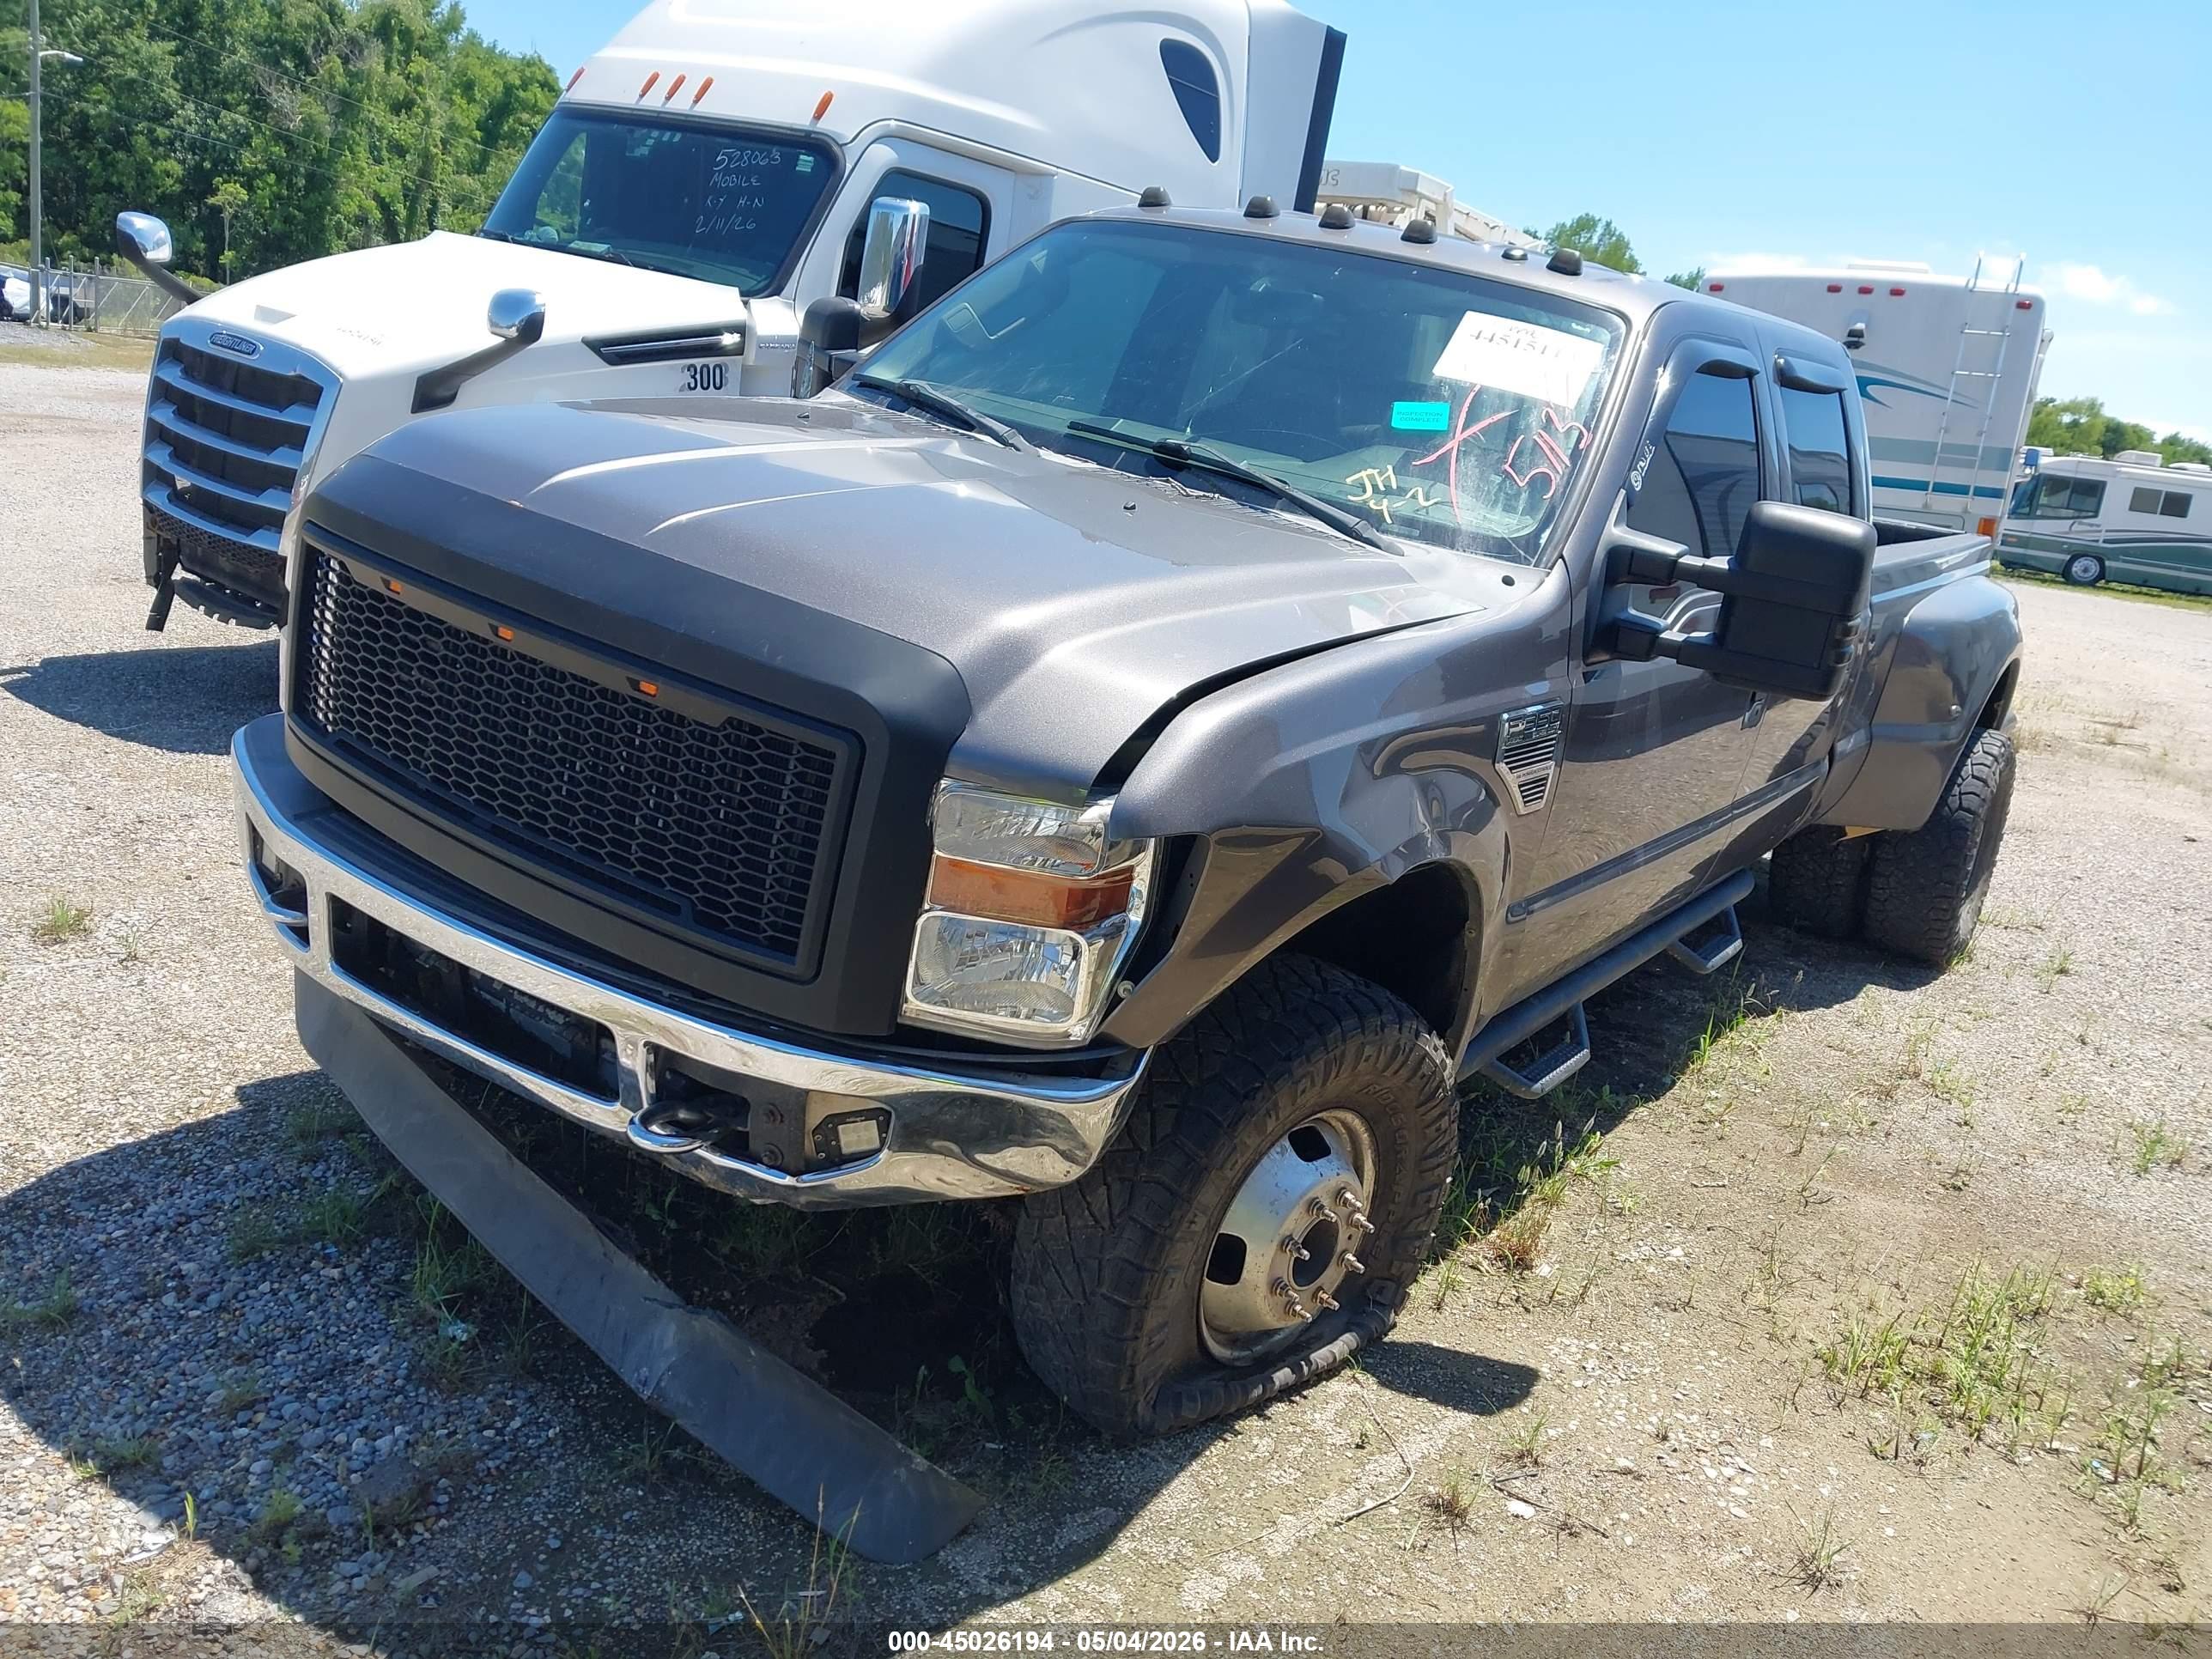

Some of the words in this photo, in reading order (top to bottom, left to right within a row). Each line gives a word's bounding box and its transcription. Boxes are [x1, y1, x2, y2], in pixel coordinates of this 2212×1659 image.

[713, 149, 781, 170] 528063
[709, 172, 762, 188] MOBILE
[695, 213, 757, 235] 2/11/26
[210, 334, 256, 354] FREIGHTLINER
[1345, 464, 1397, 501] JH
